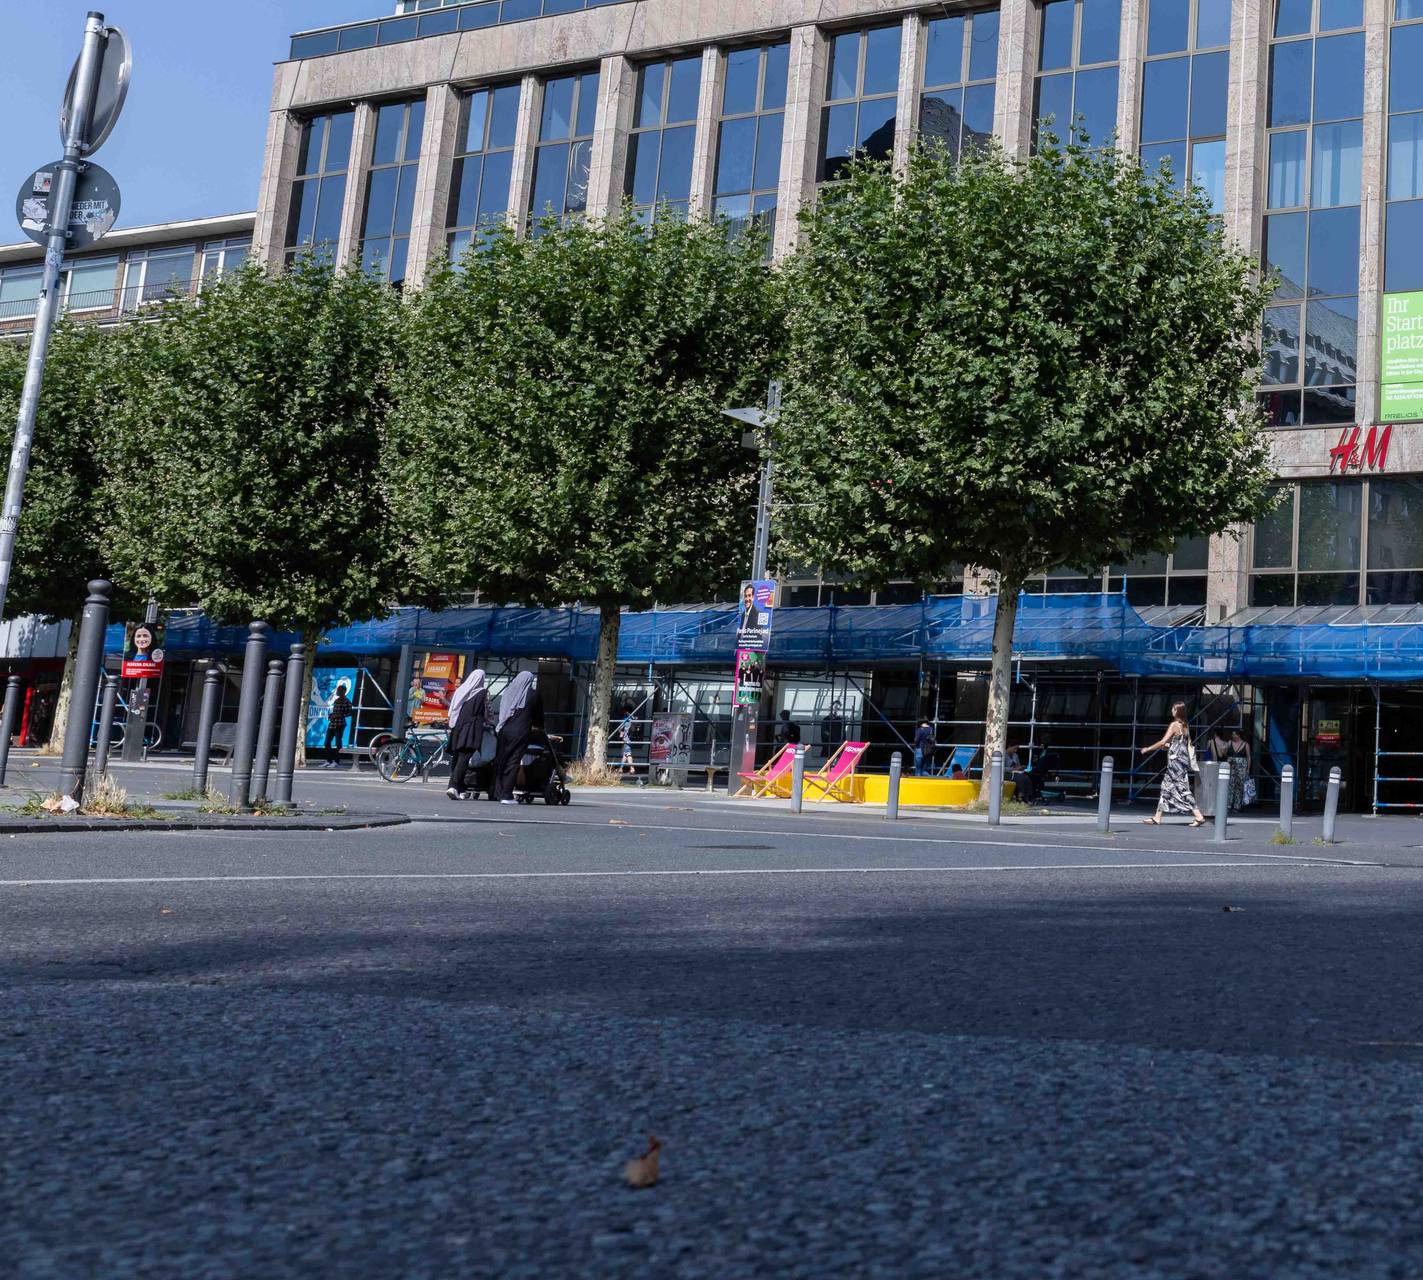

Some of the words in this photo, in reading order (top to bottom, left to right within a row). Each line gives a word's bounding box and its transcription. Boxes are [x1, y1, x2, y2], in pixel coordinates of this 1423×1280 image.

[1387, 298, 1408, 313] Ihr
[1386, 334, 1423, 354] platz
[1330, 423, 1392, 474] H&M
